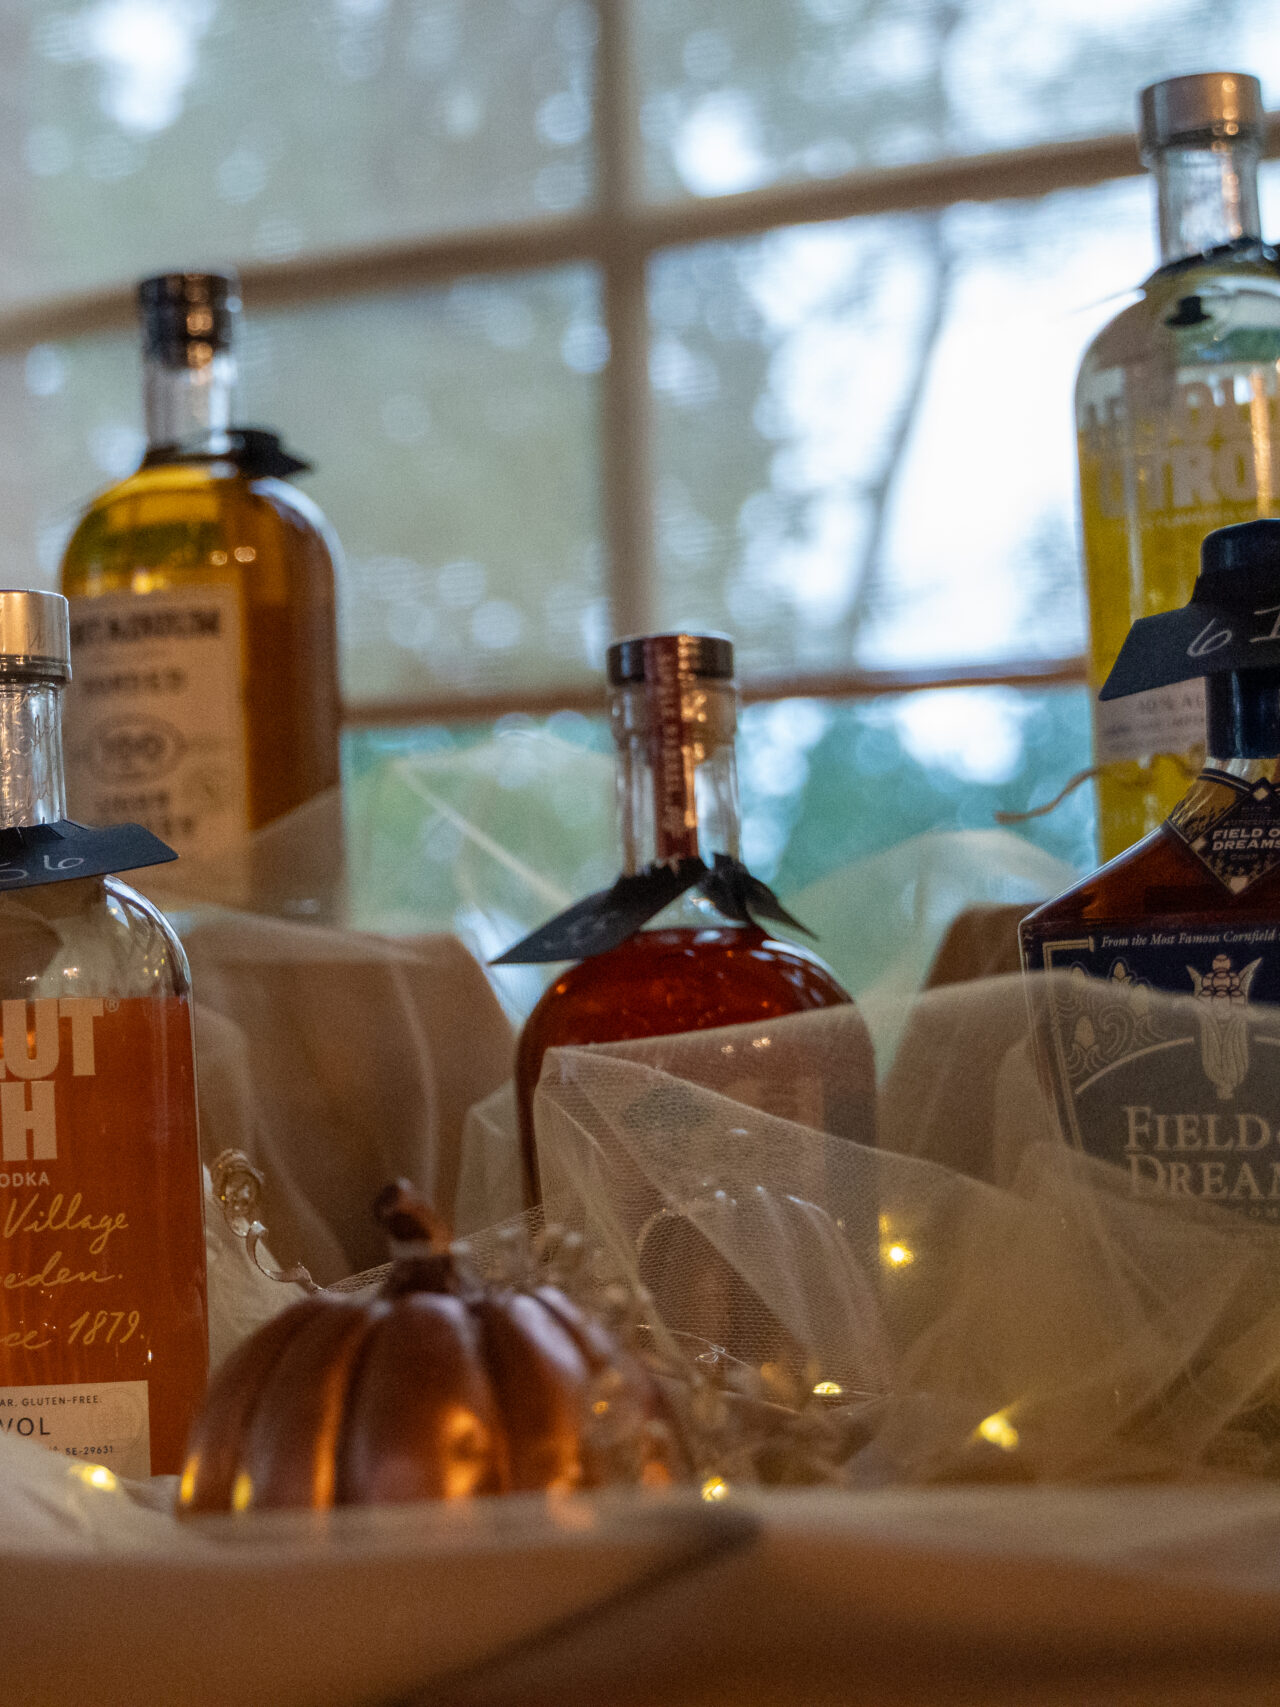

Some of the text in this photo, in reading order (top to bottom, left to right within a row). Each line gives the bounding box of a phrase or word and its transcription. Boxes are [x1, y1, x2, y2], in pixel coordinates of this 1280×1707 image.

[1213, 828, 1263, 841] FIELD
[1101, 936, 1129, 948] From
[1223, 928, 1277, 944] Cornfield
[1122, 1105, 1271, 1151] FIELD
[3, 1192, 129, 1255] Village
[65, 1445, 114, 1457] SE-29631
